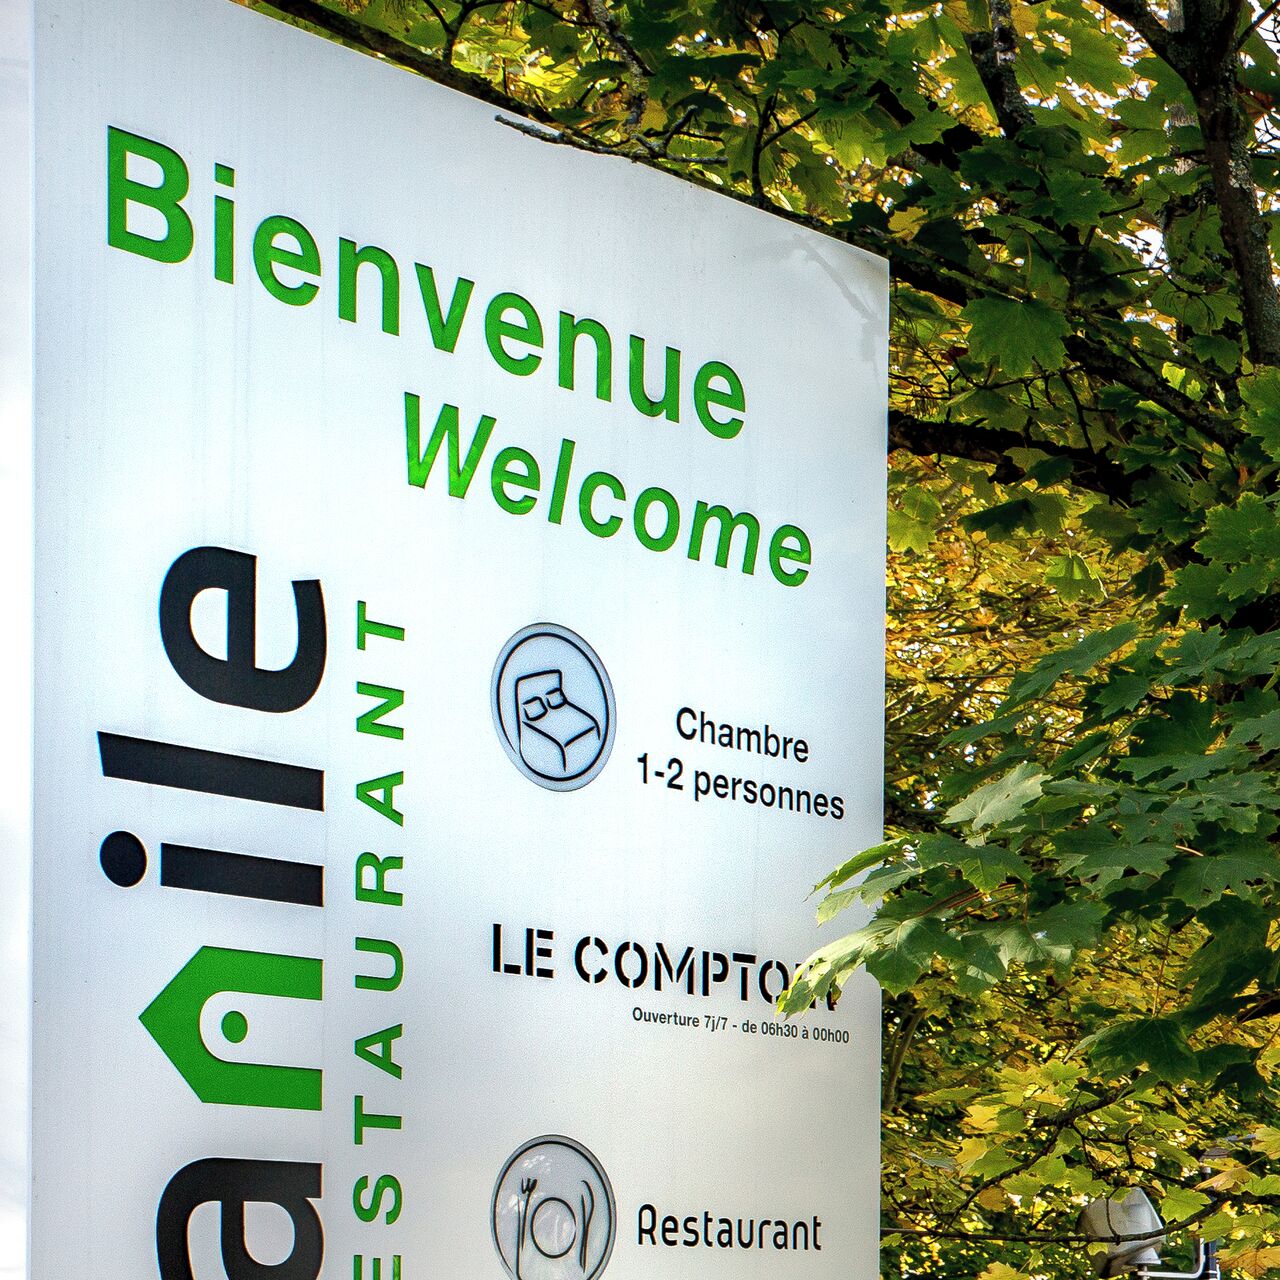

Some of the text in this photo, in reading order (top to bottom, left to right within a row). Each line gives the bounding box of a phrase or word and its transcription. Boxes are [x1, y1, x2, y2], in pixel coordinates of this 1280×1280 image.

[107, 126, 747, 440] Bienvenue
[404, 391, 812, 588] Welcome
[676, 706, 809, 763] Chambre
[637, 752, 845, 820] 1-2 personnes
[492, 923, 837, 1011] LE COMPTO
[632, 1006, 700, 1027] Ouverture
[704, 1014, 728, 1032] 7j/7
[742, 1020, 757, 1034] de
[761, 1021, 798, 1038] 06h30
[802, 1025, 809, 1039] à
[812, 1027, 850, 1043] 00h00
[637, 1203, 823, 1251] Restaurant
